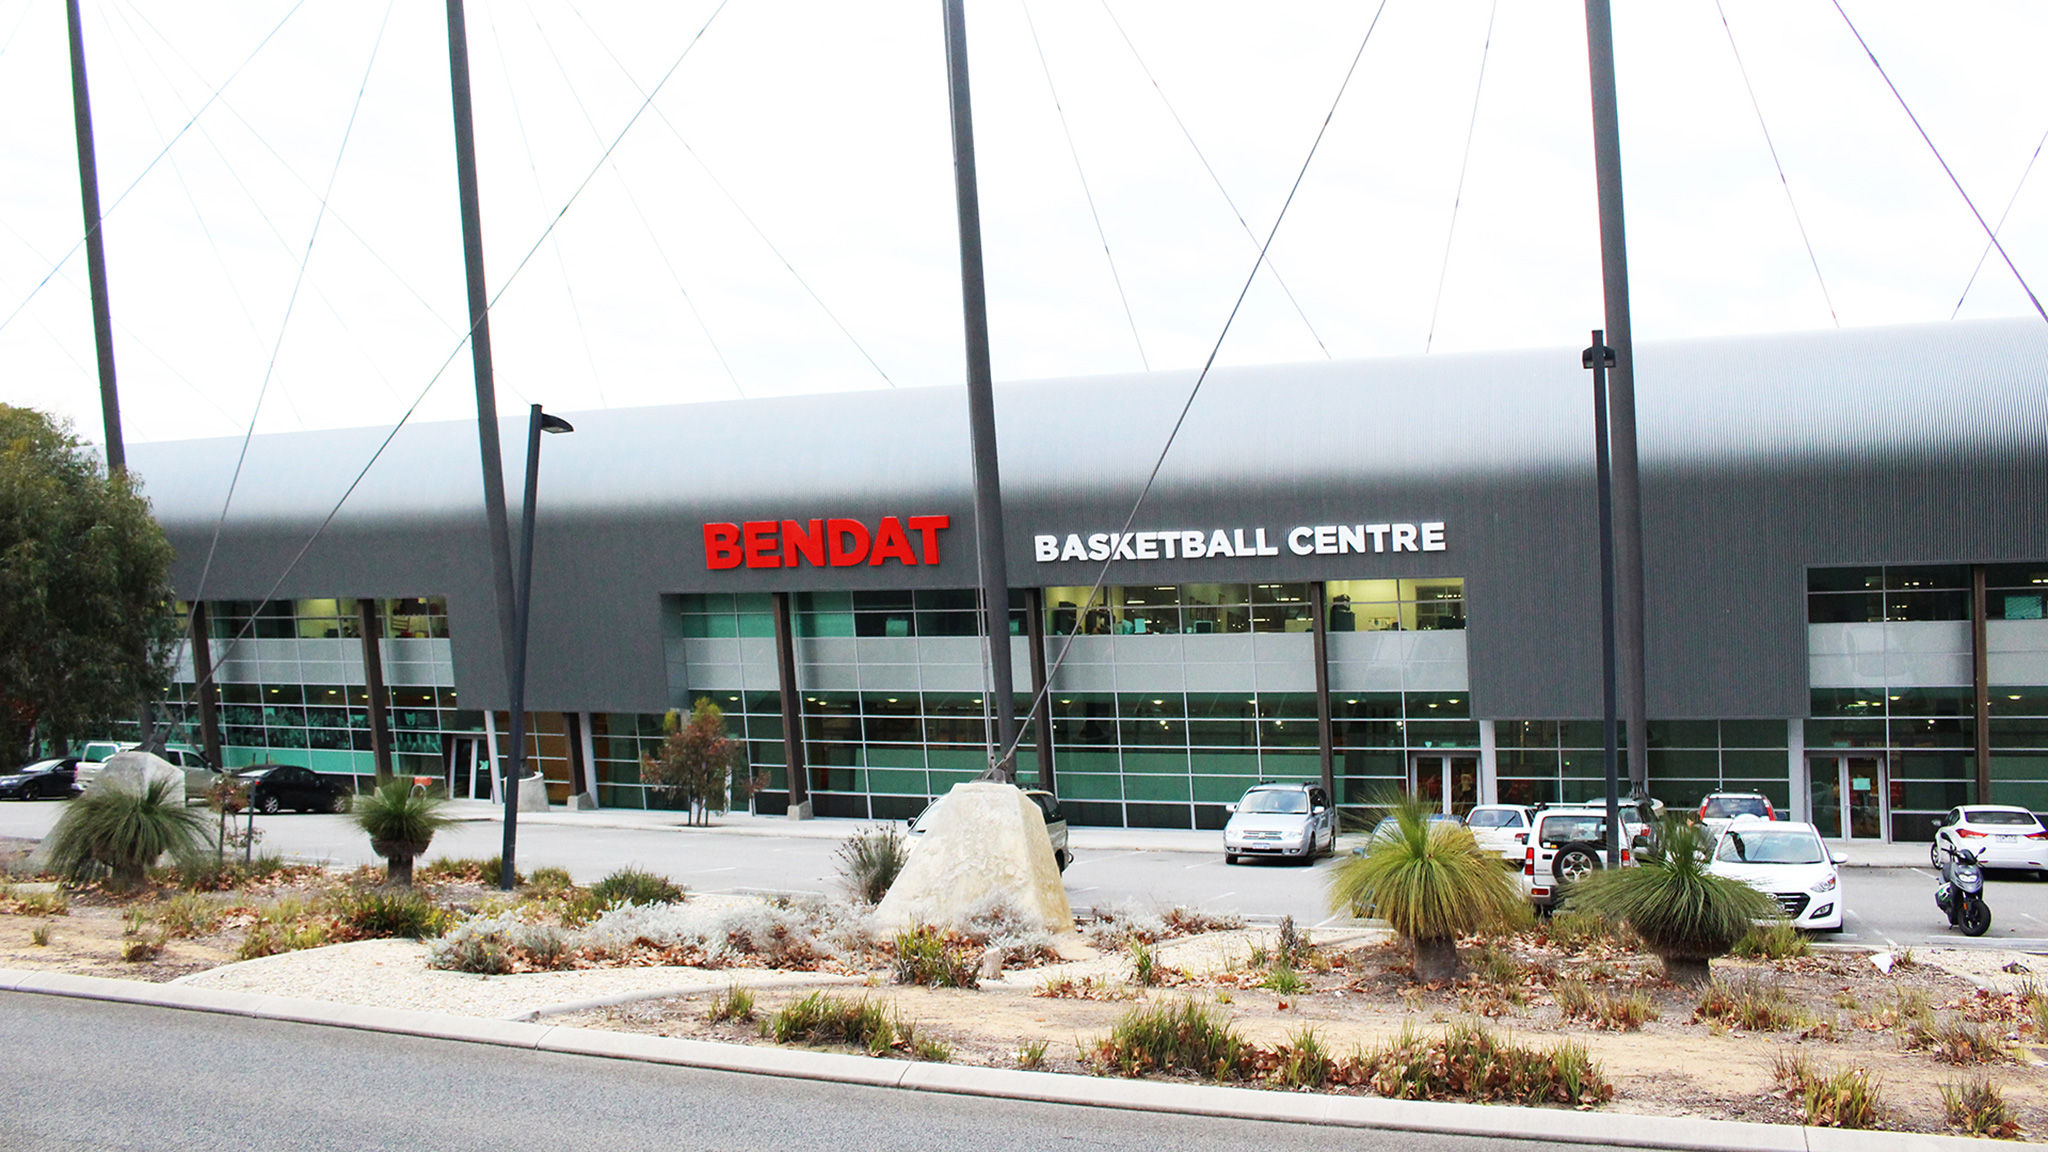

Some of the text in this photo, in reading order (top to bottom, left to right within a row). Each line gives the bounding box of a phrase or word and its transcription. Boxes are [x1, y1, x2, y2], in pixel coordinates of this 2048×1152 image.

[703, 514, 949, 569] BENDAT
[1034, 521, 1448, 562] BASKETBALL CENTRE
